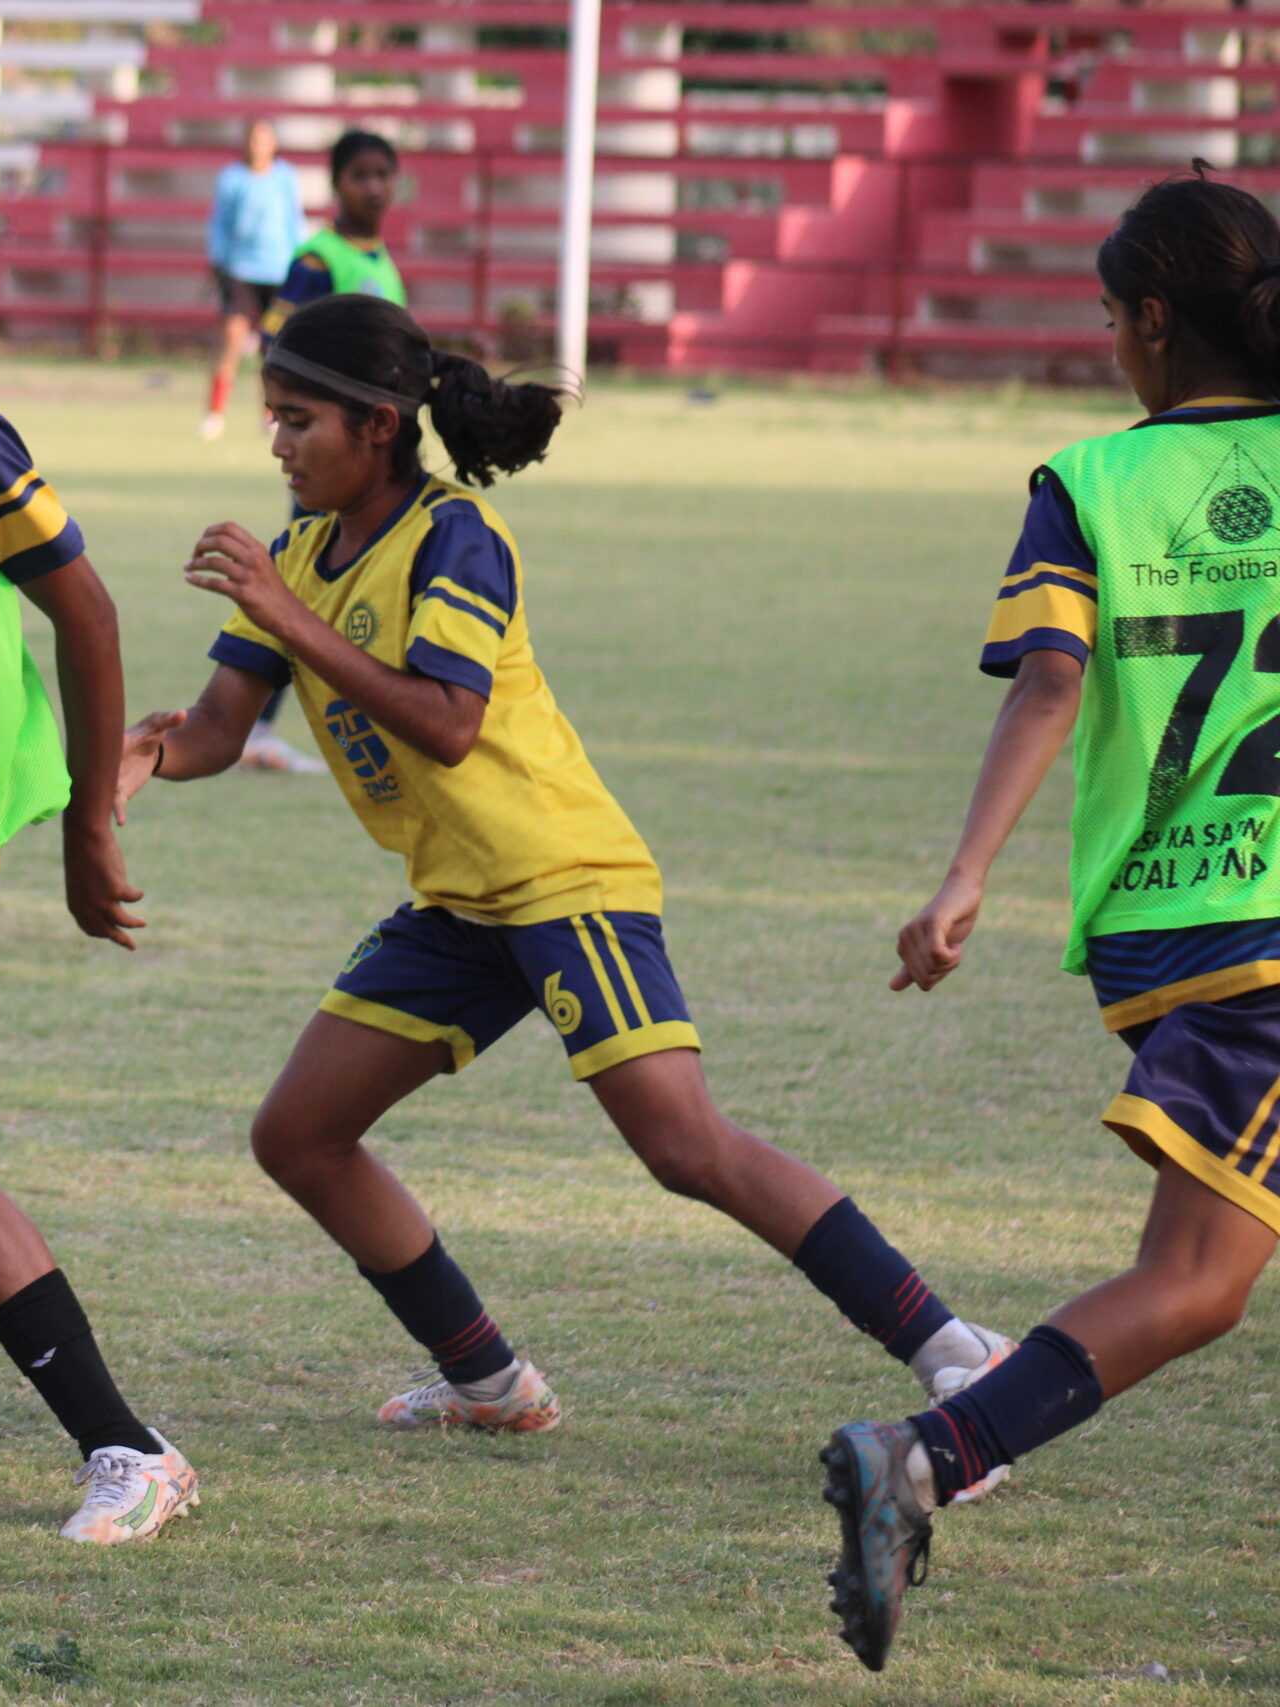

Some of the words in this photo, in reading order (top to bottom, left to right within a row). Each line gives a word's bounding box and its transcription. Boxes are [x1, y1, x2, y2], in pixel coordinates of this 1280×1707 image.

[1129, 563, 1179, 586] The
[1167, 825, 1195, 849] KA
[544, 970, 583, 1035] 6
